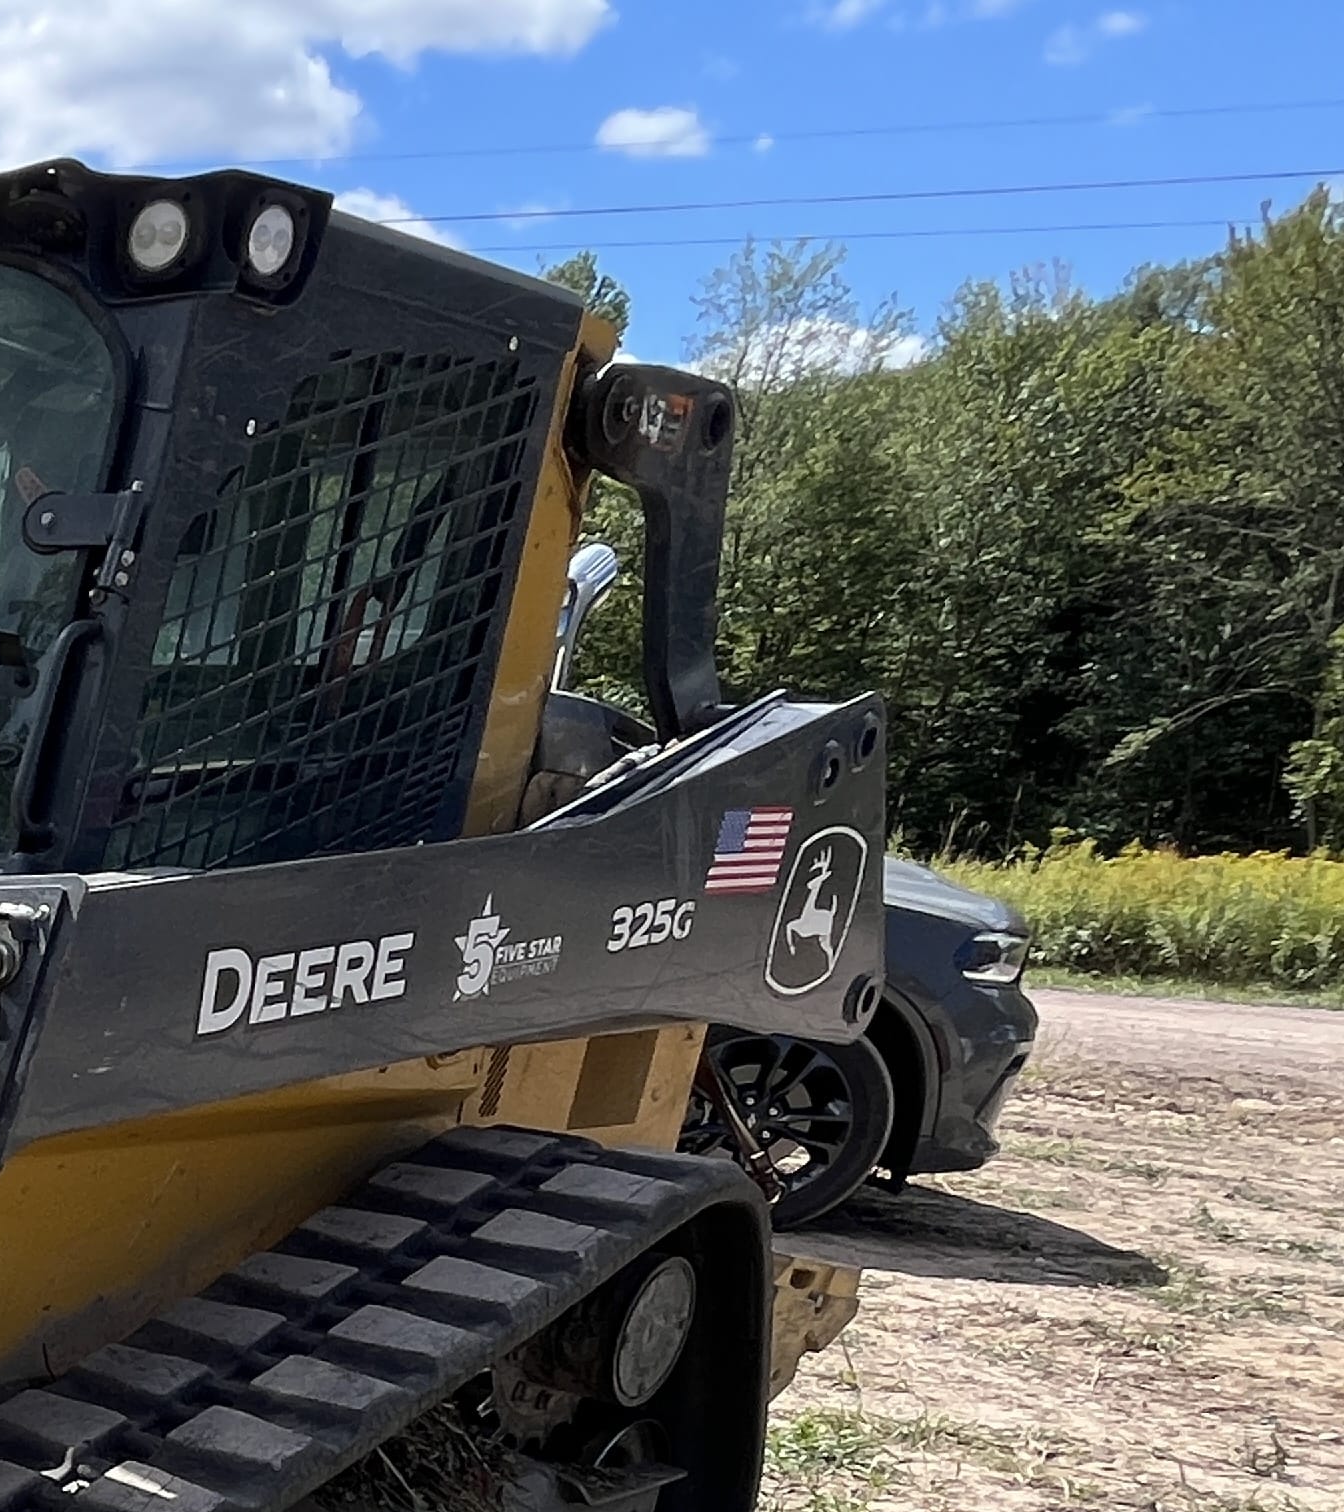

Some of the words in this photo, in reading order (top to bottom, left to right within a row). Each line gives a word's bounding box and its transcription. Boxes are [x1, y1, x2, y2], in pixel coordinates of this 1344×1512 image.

[607, 899, 695, 952] 325G
[490, 956, 559, 985] EQUIPMENT
[494, 942, 527, 965] FIVE
[527, 936, 562, 957] STAR
[197, 932, 415, 1035] DEERE
